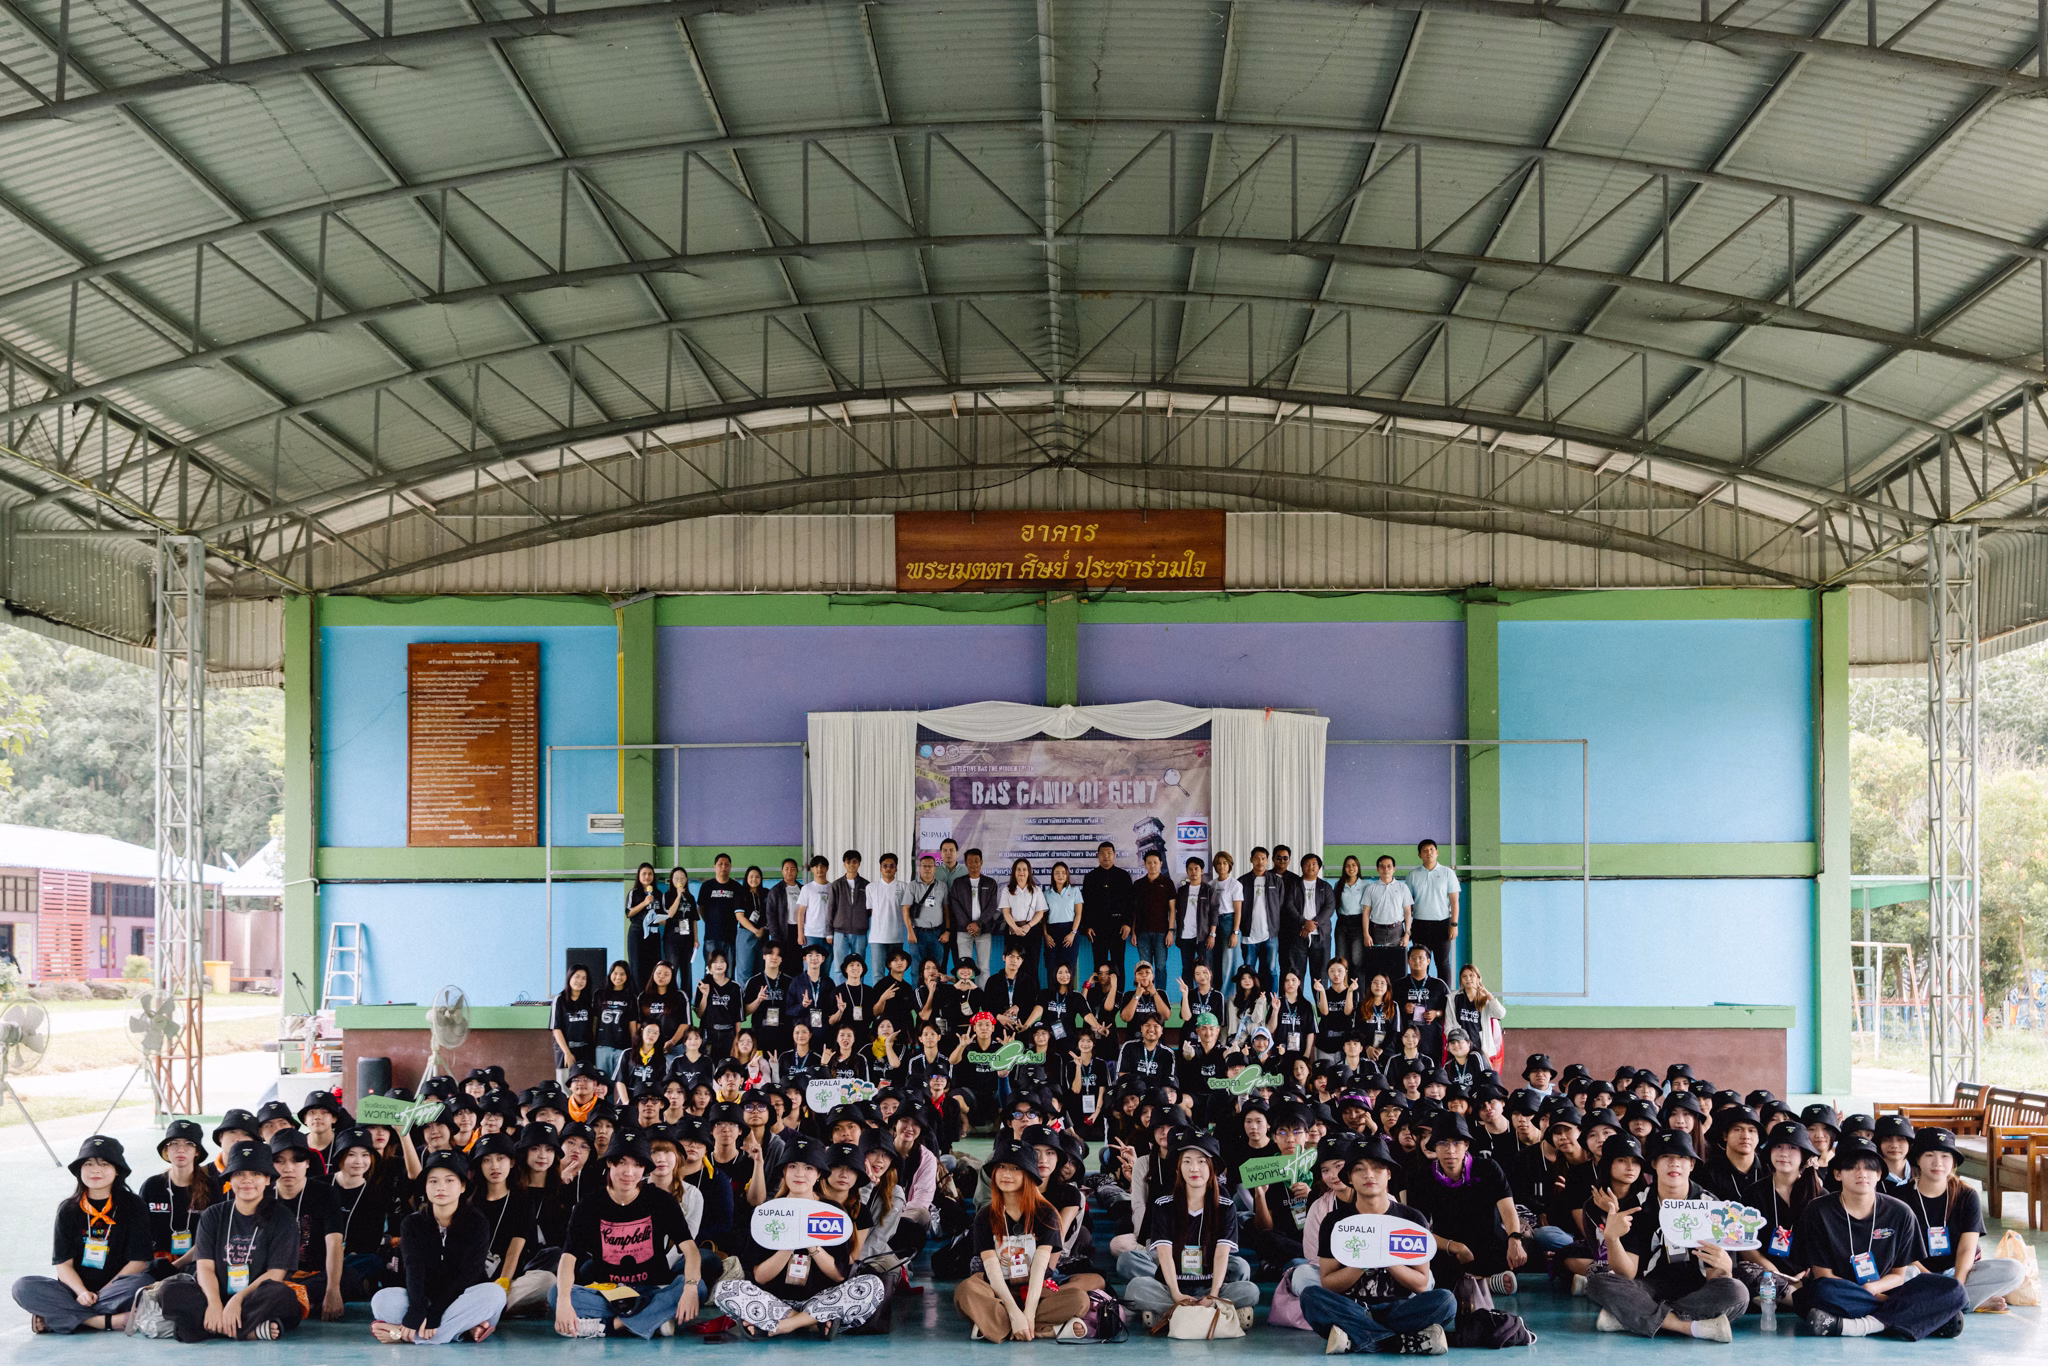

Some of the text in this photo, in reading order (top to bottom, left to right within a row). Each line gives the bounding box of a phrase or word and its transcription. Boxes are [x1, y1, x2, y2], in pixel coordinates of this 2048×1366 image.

[1021, 524, 1099, 543] อาคาร
[905, 549, 1207, 580] พระเมตตา ศิษย์ ประชาร่วมใจ
[972, 780, 1011, 805] BAS
[1016, 780, 1074, 805] CAMP
[1079, 781, 1103, 804] OF
[1178, 827, 1207, 838] TOA
[604, 1009, 624, 1024] 67
[364, 1095, 443, 1136] พวกหนู Happy
[1247, 1167, 1287, 1183] พวกหนู
[757, 1208, 795, 1217] SUPALAI
[1663, 1200, 1709, 1210] SUPALAI
[808, 1219, 842, 1233] TOA
[1337, 1224, 1376, 1234] SUPALAI
[1390, 1236, 1426, 1252] TOA
[609, 1272, 649, 1283] TOMATO
